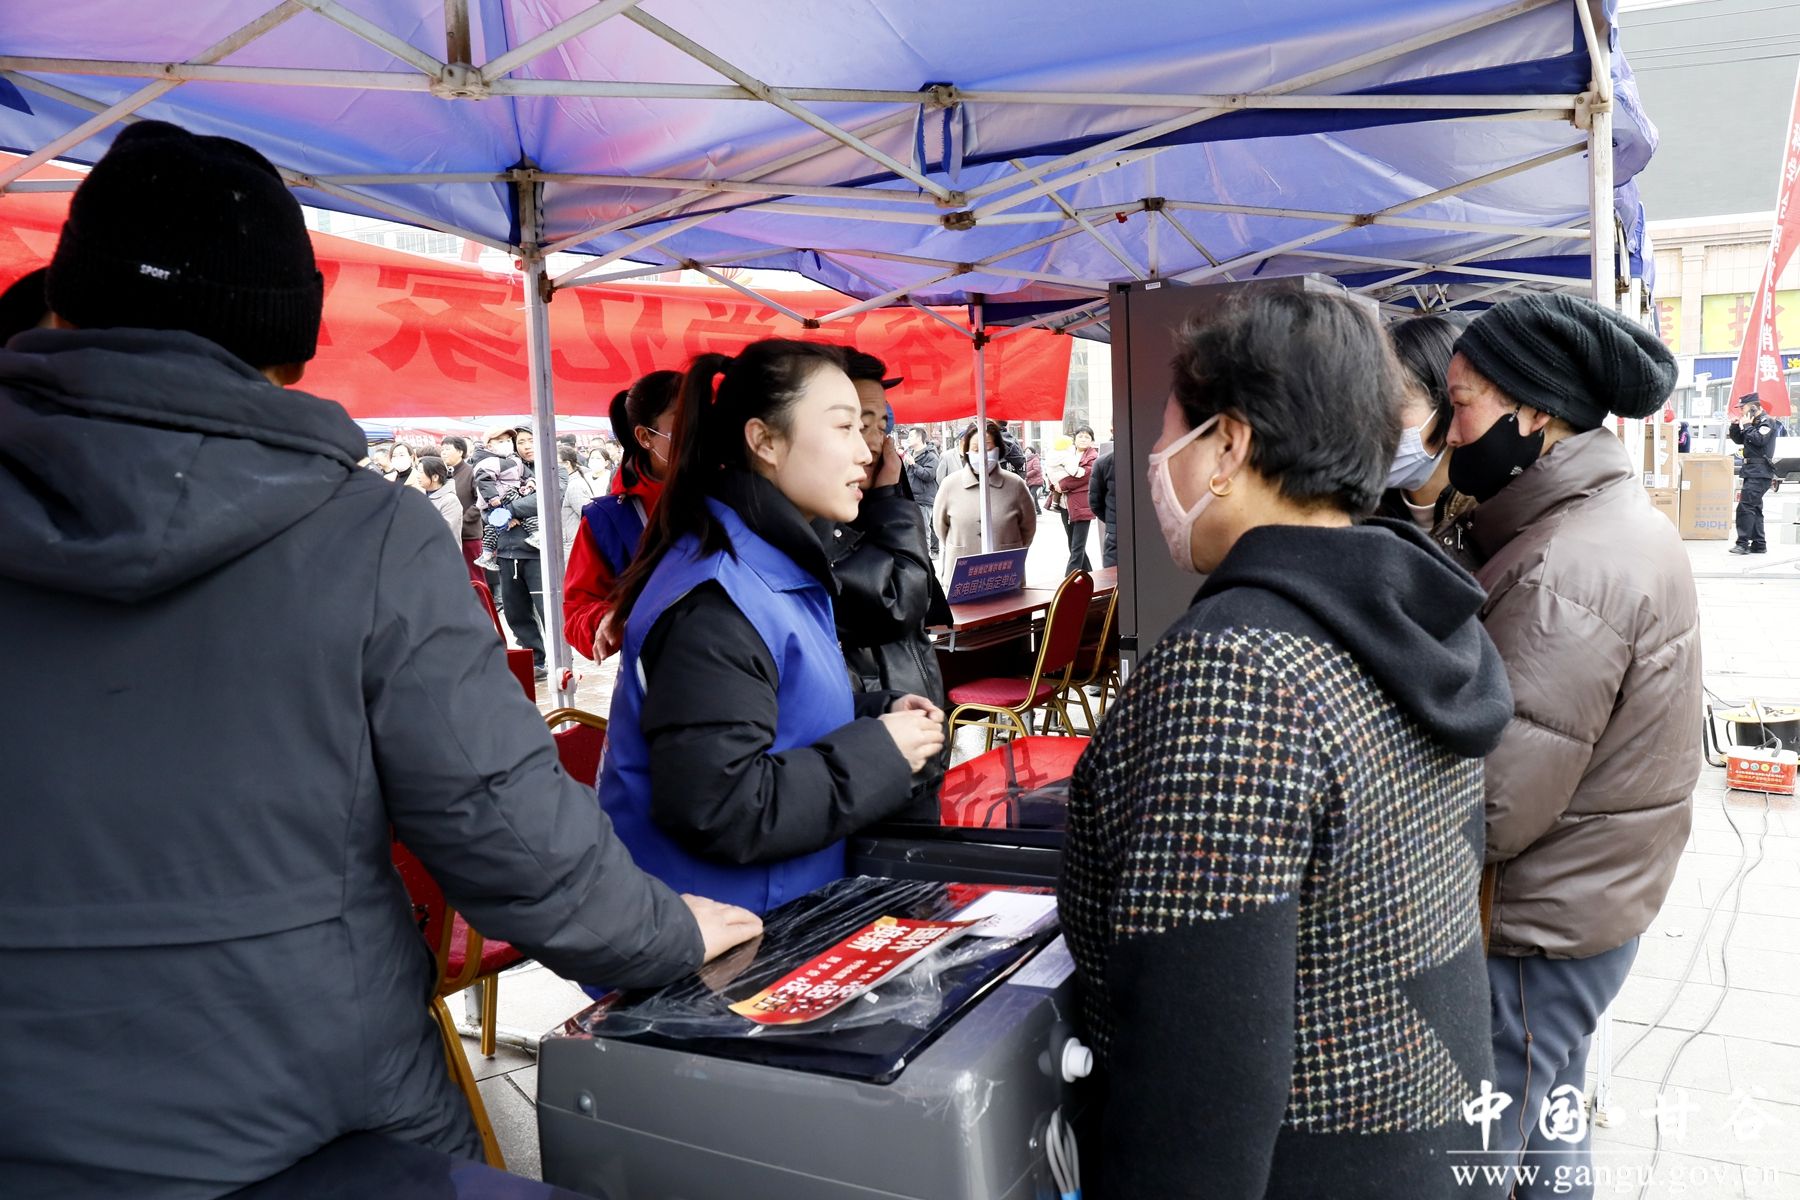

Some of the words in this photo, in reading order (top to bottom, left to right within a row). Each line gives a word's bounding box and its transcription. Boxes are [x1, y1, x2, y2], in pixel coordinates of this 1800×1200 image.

[139, 263, 171, 281] SPORT
[953, 573, 1017, 597] 家电国补指定单位
[847, 924, 911, 953] 换新
[888, 927, 949, 953] 国补
